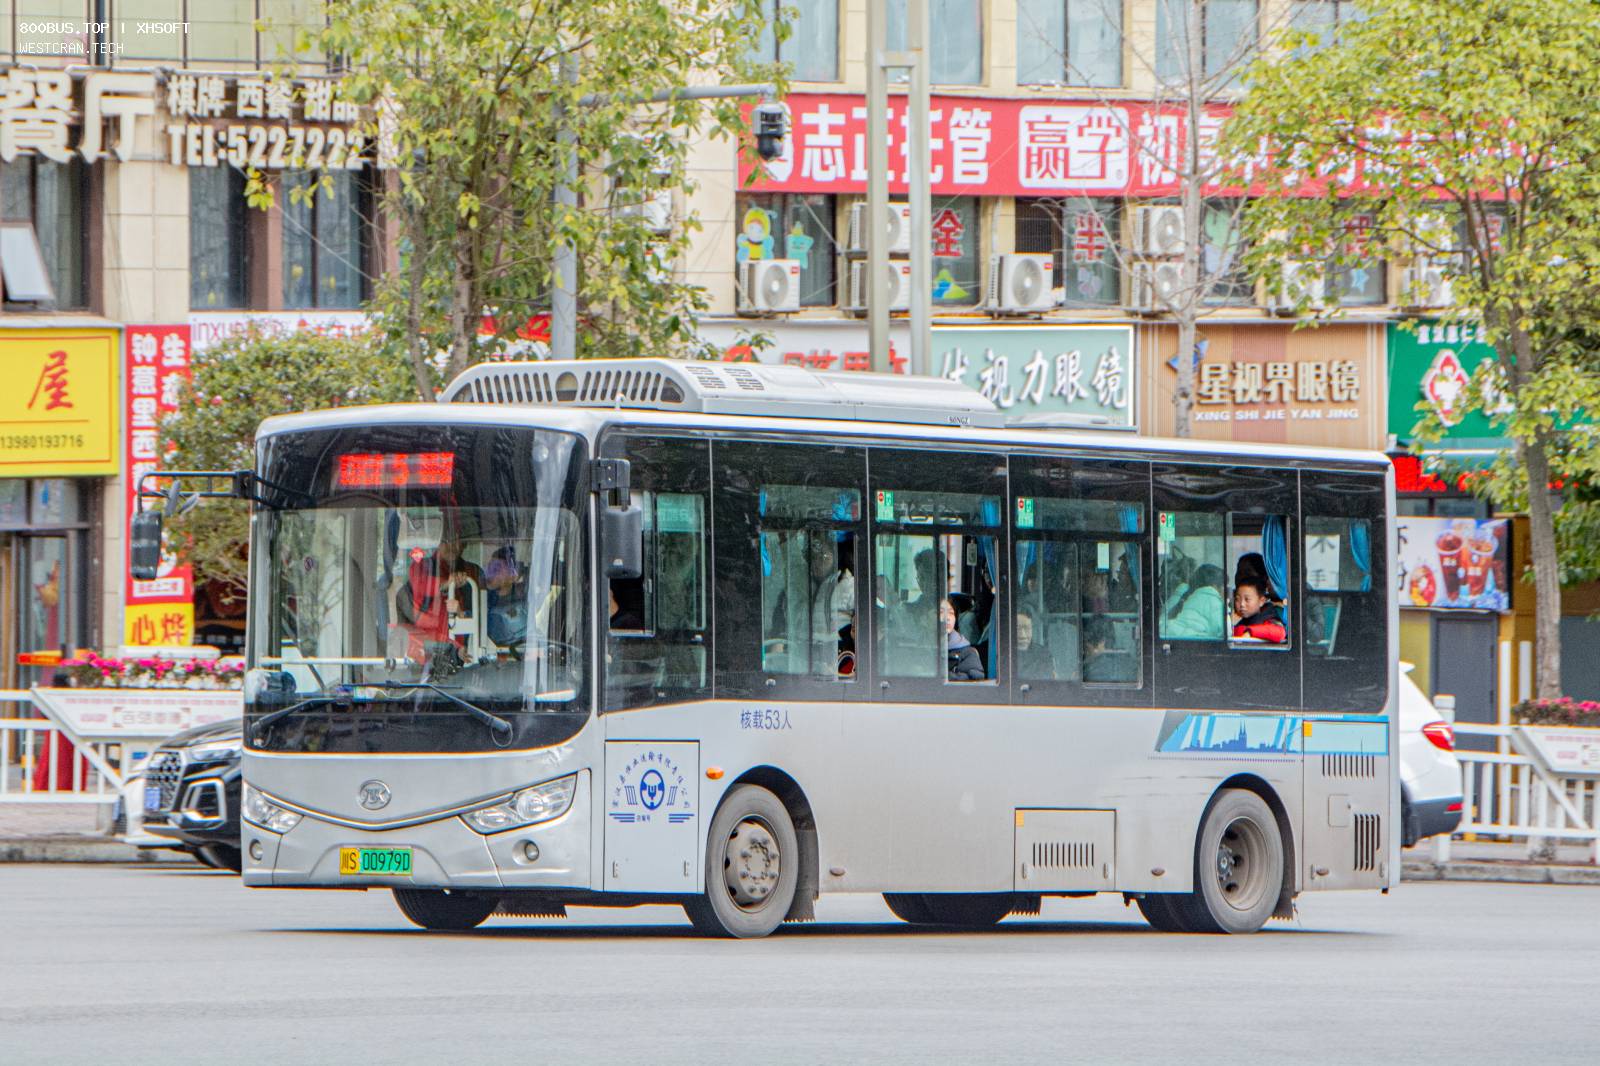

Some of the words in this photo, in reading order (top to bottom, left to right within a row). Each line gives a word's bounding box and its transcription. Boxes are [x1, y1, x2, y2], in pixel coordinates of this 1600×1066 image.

[0, 70, 156, 163] 餐厅
[166, 75, 228, 118] 棋牌
[236, 78, 292, 120] 西餐
[758, 102, 992, 185] 志正托管
[932, 209, 964, 257] 全
[27, 350, 74, 410] 屋
[1198, 360, 1360, 404] 星视界眼镜
[1195, 411, 1230, 421] XING
[1235, 410, 1259, 420] SHI
[1264, 409, 1285, 420] JIE
[1290, 409, 1322, 419] YAN
[1327, 408, 1359, 419] JING
[741, 709, 792, 730] 核载53人
